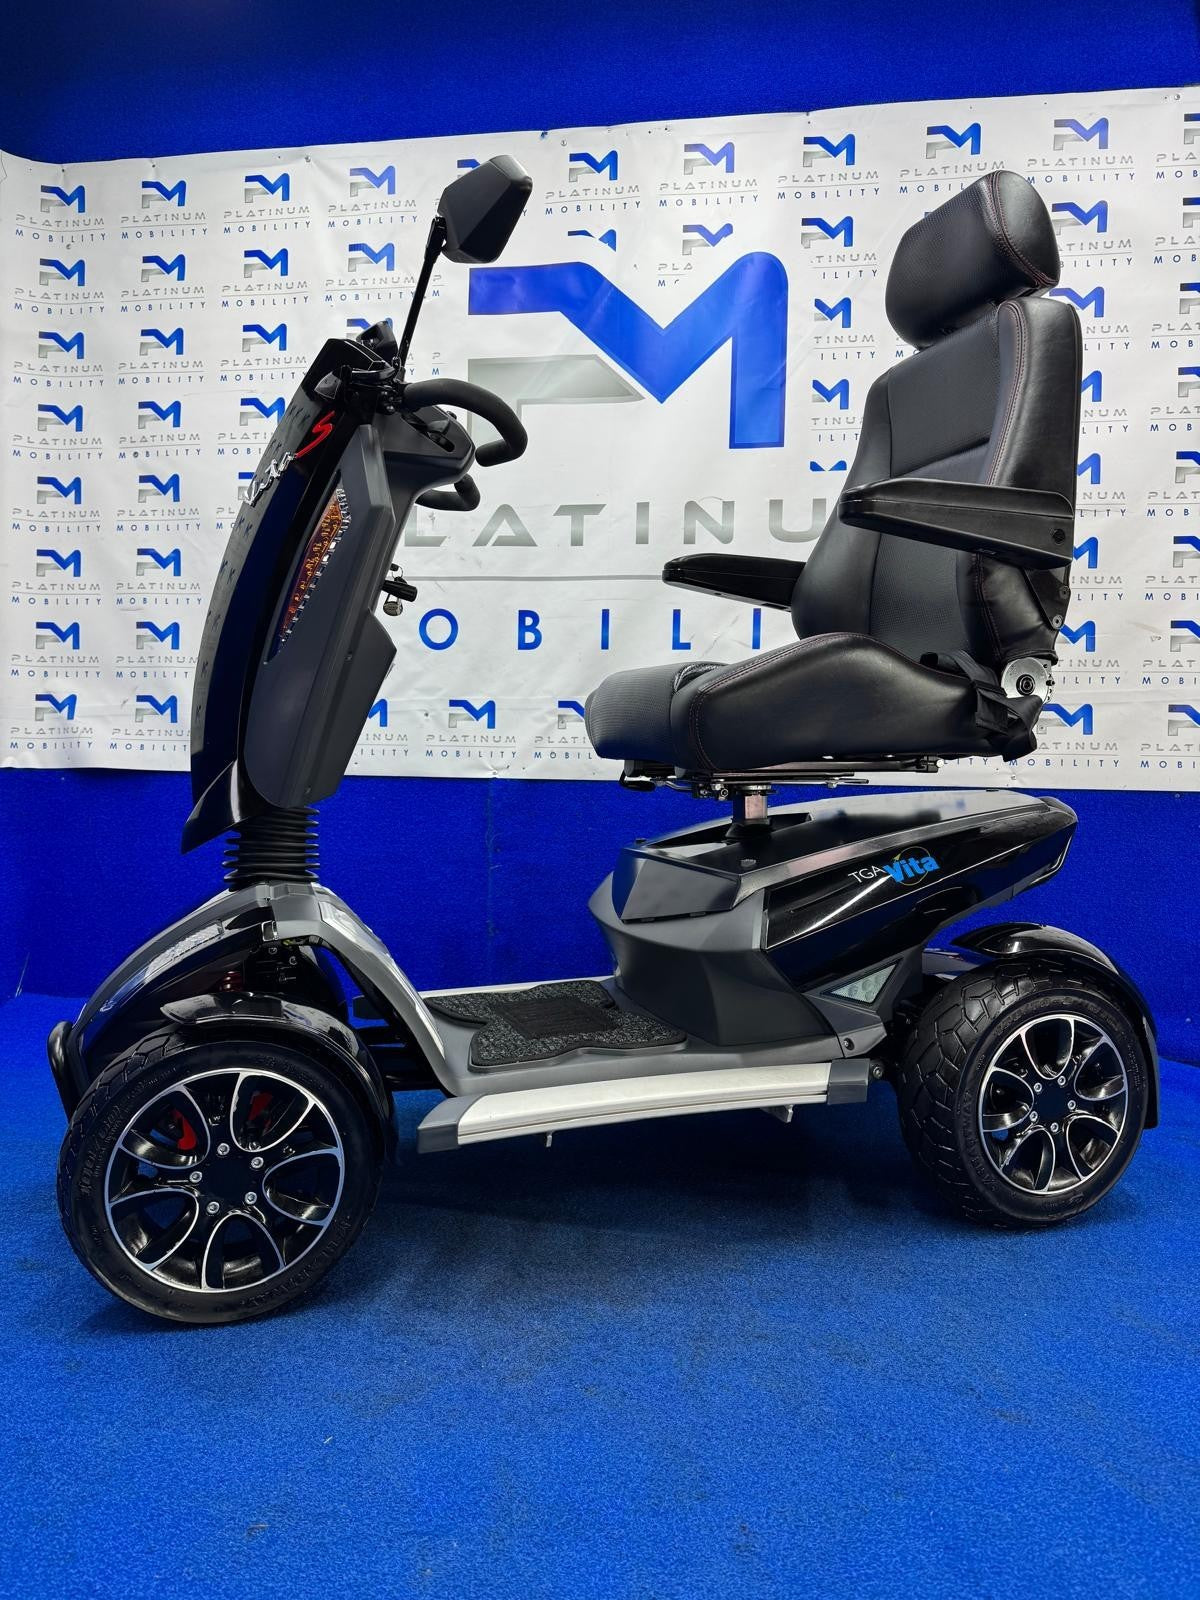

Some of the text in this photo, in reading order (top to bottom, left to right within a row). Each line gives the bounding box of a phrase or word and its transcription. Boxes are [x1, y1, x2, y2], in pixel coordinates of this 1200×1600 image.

[1028, 156, 1133, 167] PLATINUM
[900, 161, 1005, 177] PLATINUM
[778, 171, 878, 183] PLATINUM
[1027, 173, 1135, 184] MOBILITY
[660, 179, 757, 191] PLATINUM
[546, 185, 639, 199] PLATINUM
[778, 188, 879, 199] MOBILITY
[328, 200, 416, 212] PLATINUM
[660, 195, 758, 207] MOBILITY
[224, 207, 310, 218] PLATINUM
[546, 201, 640, 214] MOBILITY
[16, 214, 104, 227] PLATINUM
[121, 212, 206, 223] PLATINUM
[328, 216, 417, 228] MOBILITY
[224, 221, 310, 233] MOBILITY
[16, 229, 105, 242] MOBILITY
[122, 229, 207, 238] MOBILITY
[811, 253, 876, 263] TINUM
[326, 276, 415, 286] PLATINUM
[222, 281, 307, 292] PLATINUM
[15, 288, 104, 300] PLATINUM
[121, 287, 204, 297] PLATINUM
[222, 296, 308, 307] MOBILITY
[15, 304, 104, 314] MOBILITY
[121, 302, 205, 312] MOBILITY
[14, 361, 103, 372] PLATINUM
[118, 361, 203, 370] PLATINUM
[220, 357, 306, 367] PLATINUM
[13, 376, 104, 387] MOBILITY
[119, 376, 204, 384] MOBILITY
[812, 417, 863, 425] TINU
[13, 435, 102, 445] PLATINUM
[120, 434, 200, 444] PLATINUM
[13, 450, 102, 460] MOBILITY
[119, 449, 201, 459] MOBILITY
[12, 508, 100, 518] PLATINUM
[117, 508, 199, 516] PLATINUM
[12, 523, 100, 532] MOBILITY
[117, 523, 200, 531] MOBILITY
[12, 581, 100, 590] PLATINUM
[116, 582, 200, 590] PLATINUM
[12, 596, 101, 605] MOBILITY
[12, 655, 99, 663] PLATINUM
[11, 669, 100, 677] MOBILITY
[112, 729, 191, 737] PLATINU
[426, 735, 516, 743] PLATINUM
[10, 741, 92, 749] MOBILITY
[848, 856, 940, 883] TGA Vita
